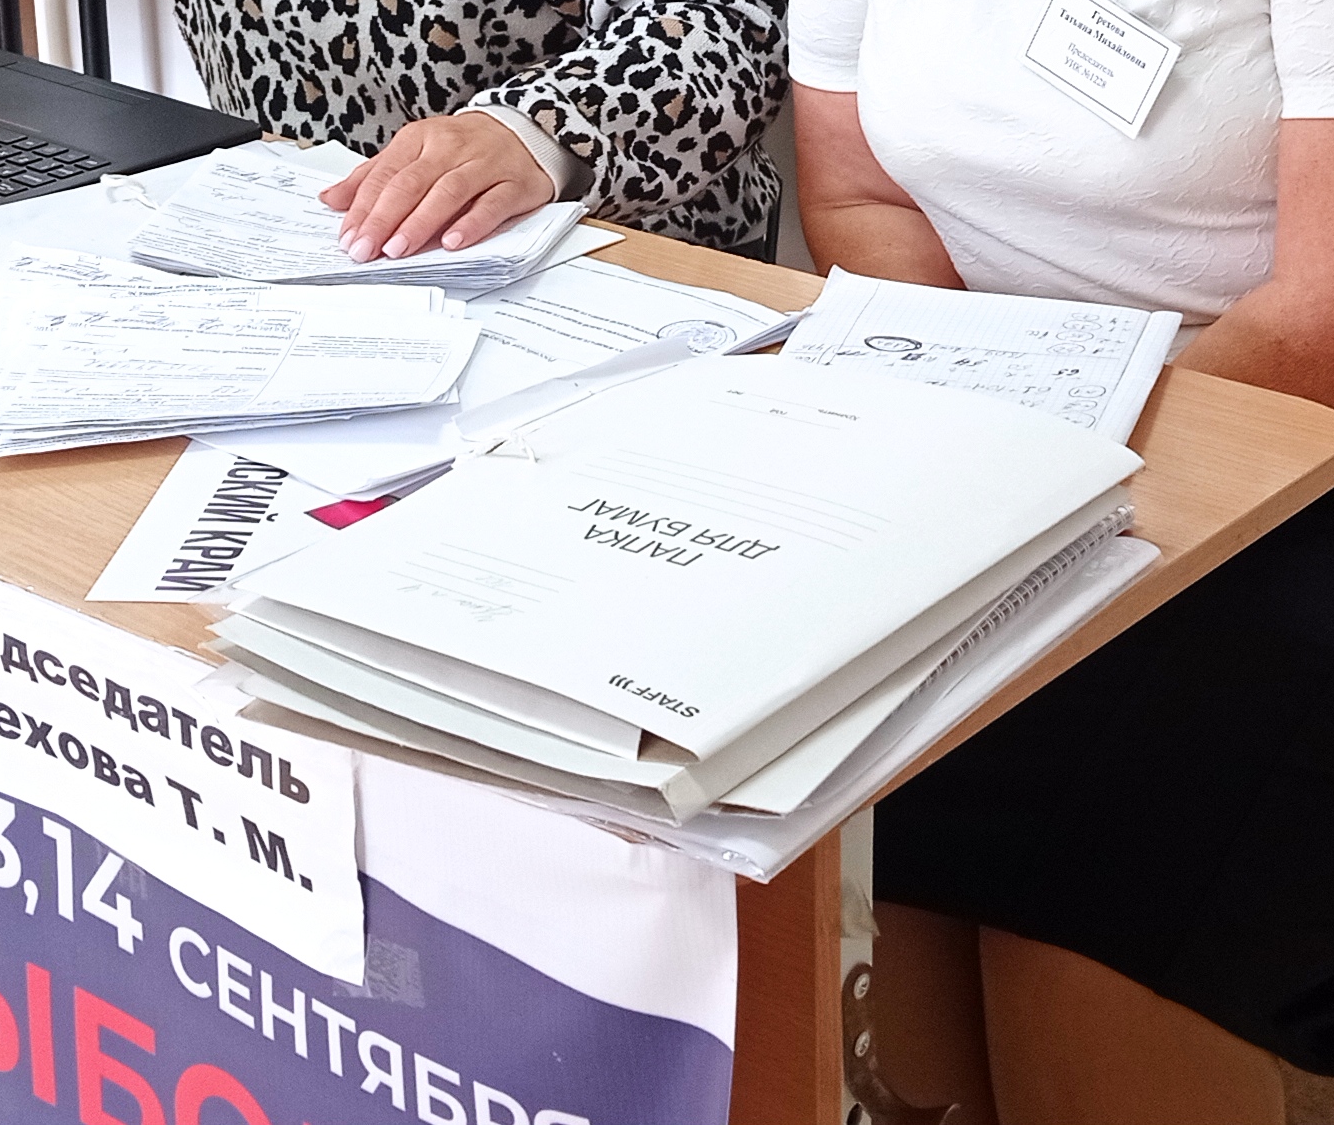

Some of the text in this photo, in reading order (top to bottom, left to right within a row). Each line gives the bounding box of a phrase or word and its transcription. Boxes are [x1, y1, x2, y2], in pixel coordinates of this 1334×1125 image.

[1059, 7, 1147, 69] Татьяна Михайловна
[1091, 10, 1126, 38] Грехова
[567, 498, 780, 560] ДЛЯ БУМАГ
[584, 524, 703, 566] ПАПКА
[631, 686, 700, 718] STAFF
[168, 926, 591, 1125] СЕНТЯБР
